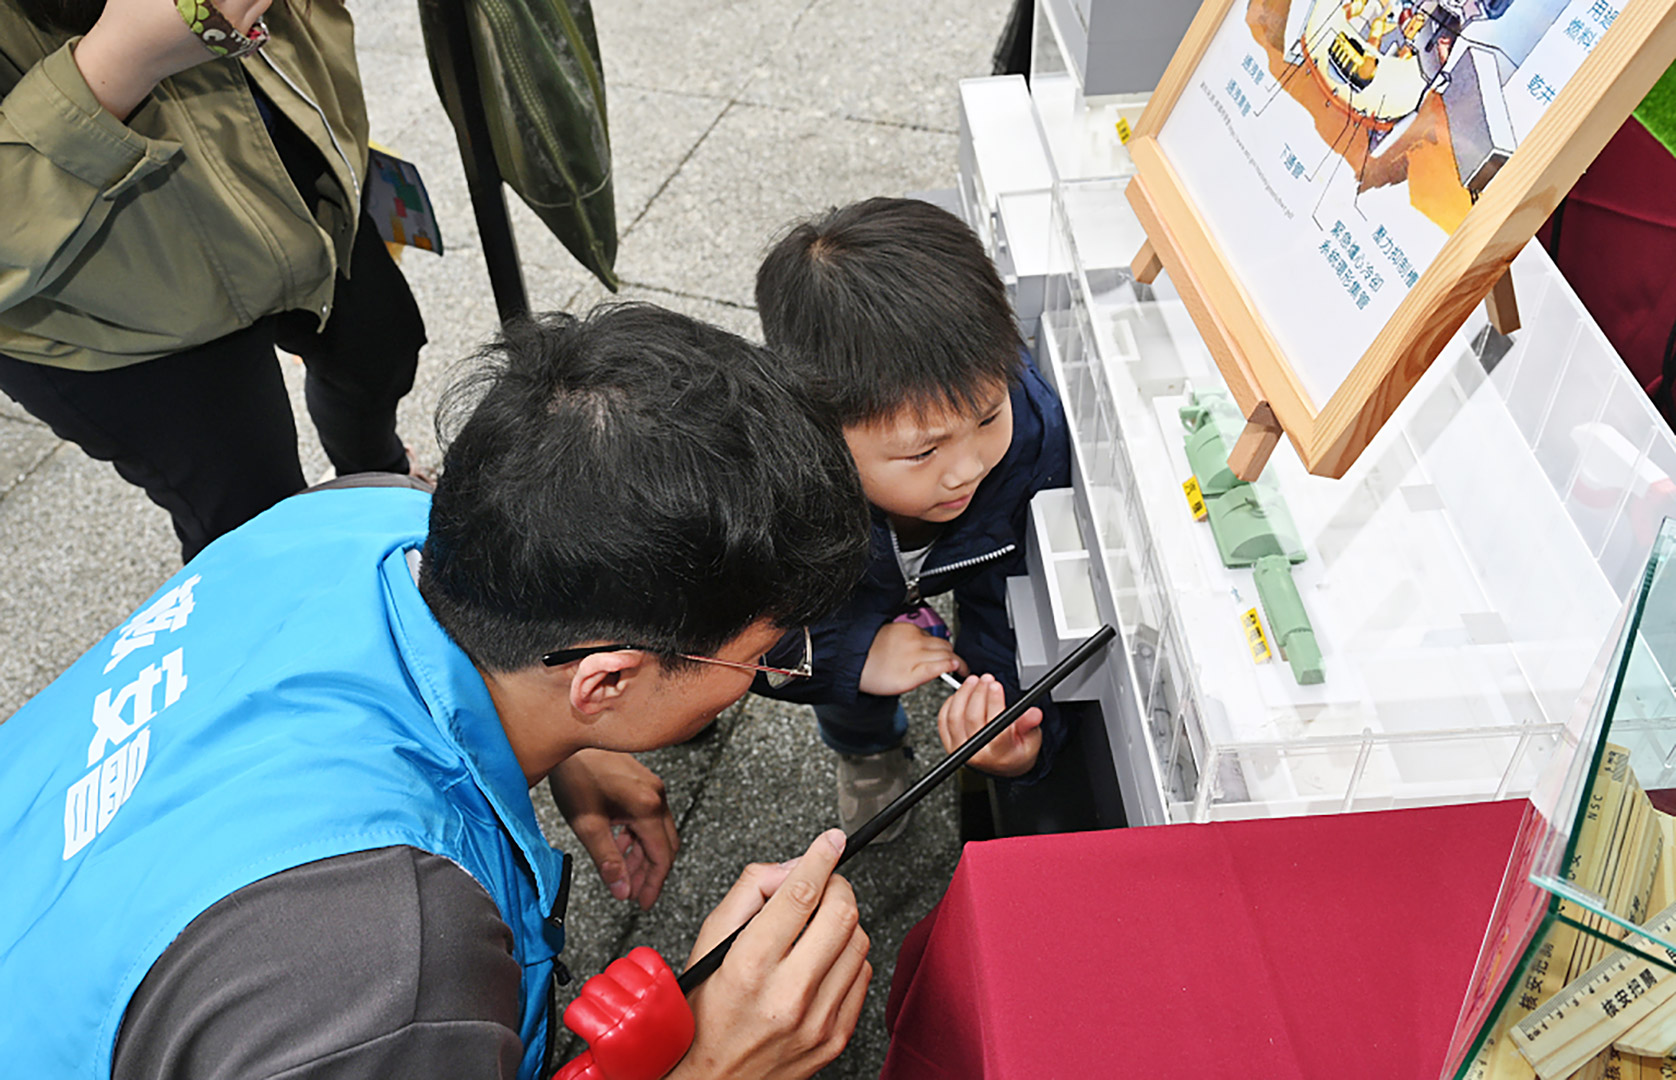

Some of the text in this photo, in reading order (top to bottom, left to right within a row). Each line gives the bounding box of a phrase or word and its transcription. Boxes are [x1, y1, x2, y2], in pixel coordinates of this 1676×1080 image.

[1526, 73, 1556, 106] 乾井
[1587, 794, 1603, 821] NSC
[1601, 967, 1657, 1018] 核安把關
